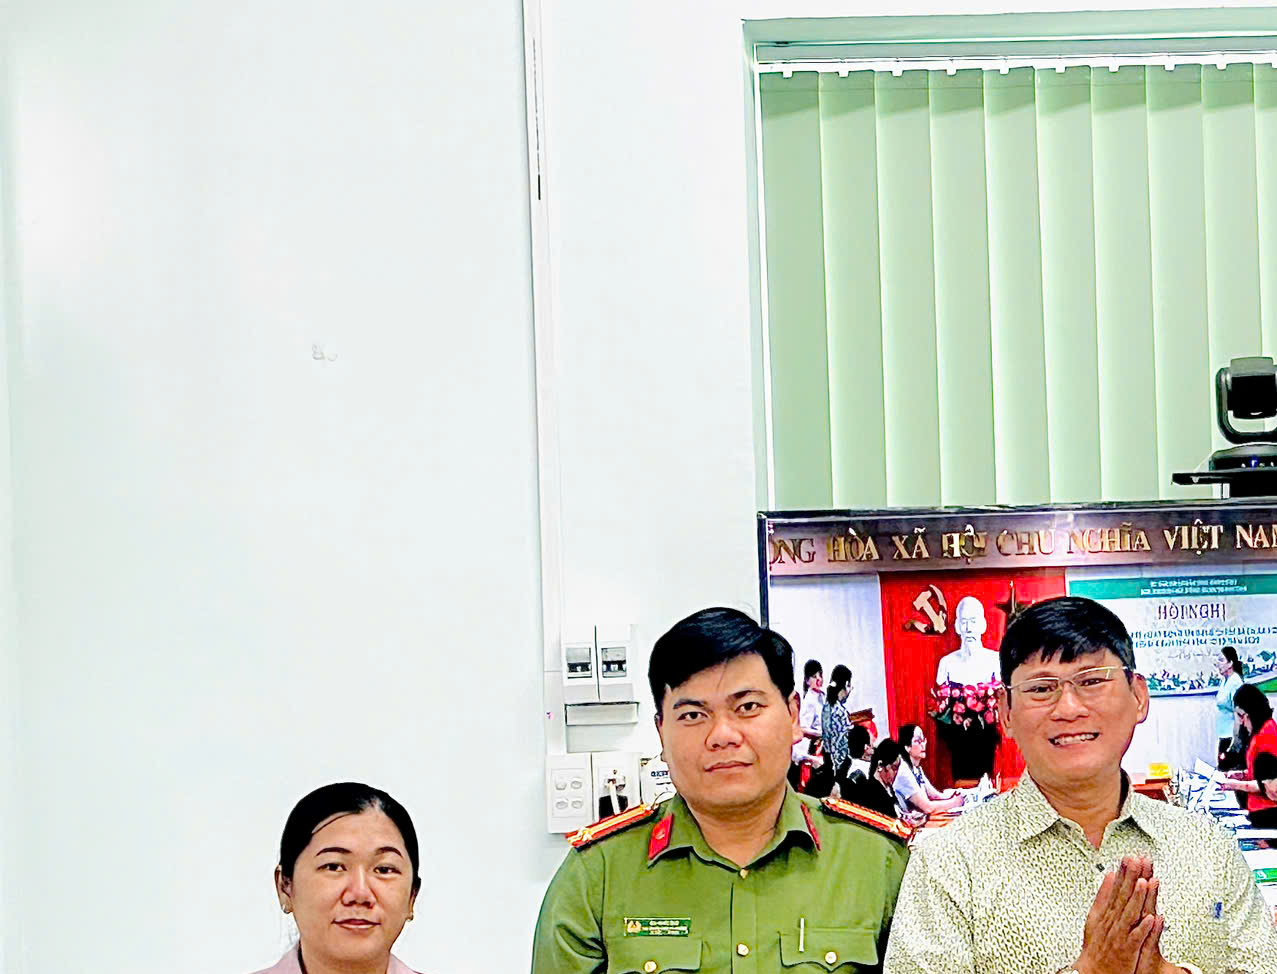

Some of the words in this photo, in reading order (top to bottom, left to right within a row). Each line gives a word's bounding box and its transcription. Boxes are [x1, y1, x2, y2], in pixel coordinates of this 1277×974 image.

[828, 527, 880, 562] HÒA
[891, 526, 931, 560] XÃ
[1066, 521, 1151, 554] NGHĨA
[1162, 518, 1225, 555] VIỆT
